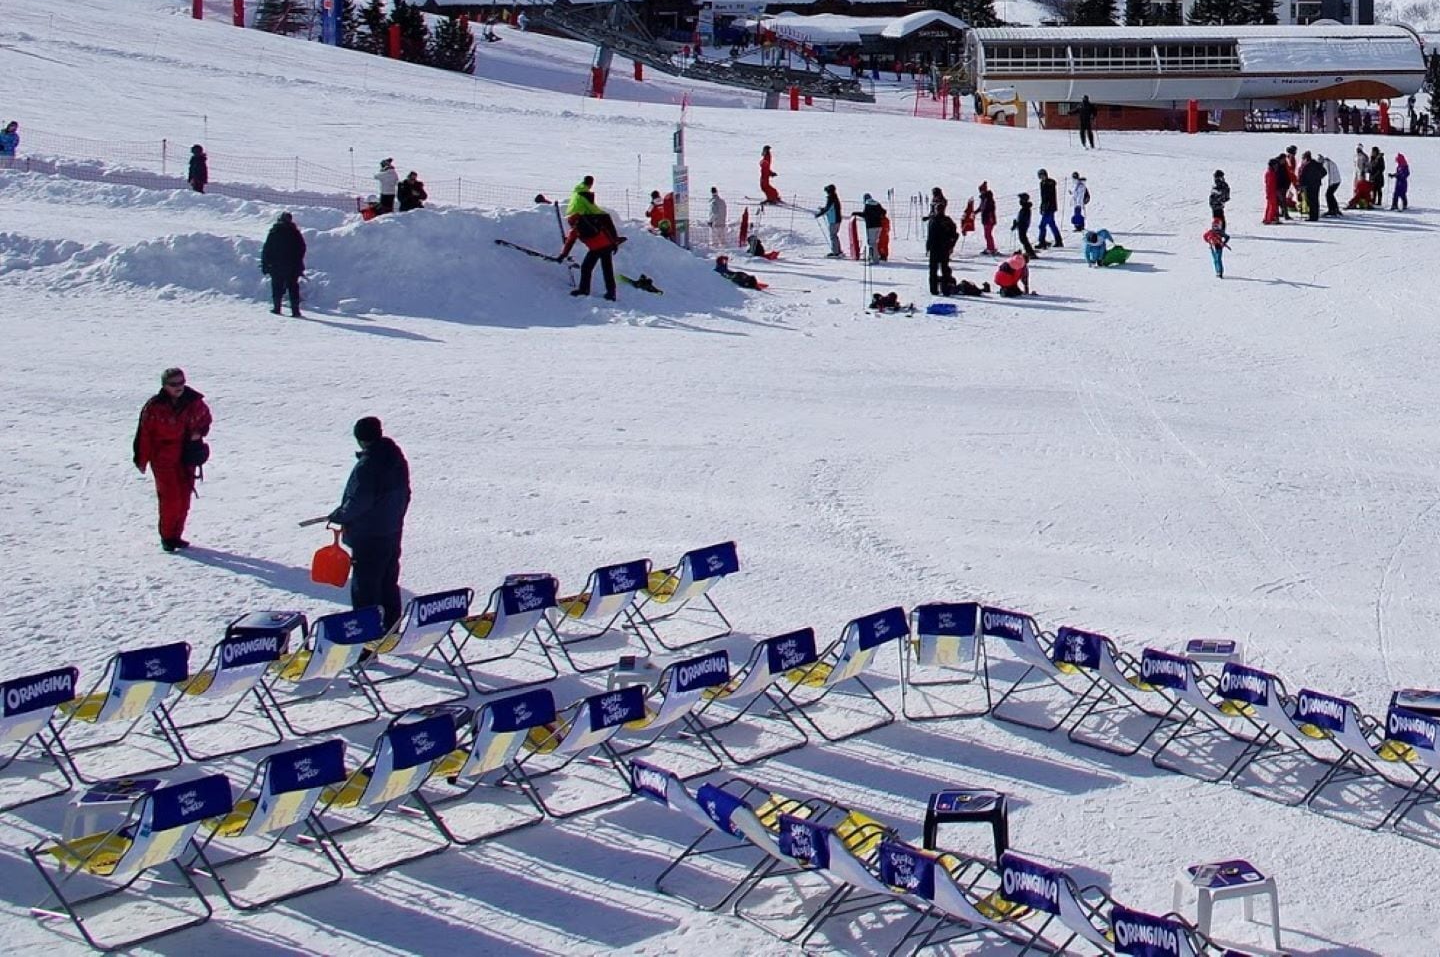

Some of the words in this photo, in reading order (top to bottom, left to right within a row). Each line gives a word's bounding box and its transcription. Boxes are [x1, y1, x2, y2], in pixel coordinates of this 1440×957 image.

[419, 595, 467, 622] ORANGINA
[224, 637, 277, 663] ORANGINA
[679, 656, 727, 687] ORANGINA
[1143, 658, 1187, 682] ORANGINA
[1221, 671, 1267, 697] ORANGINA
[7, 675, 71, 709] ORANGINA
[1299, 694, 1344, 722] ORANGINA
[1390, 713, 1436, 742] ORANGINA
[1003, 868, 1058, 904] ORANGINA
[1115, 920, 1178, 955] ORANGINA
